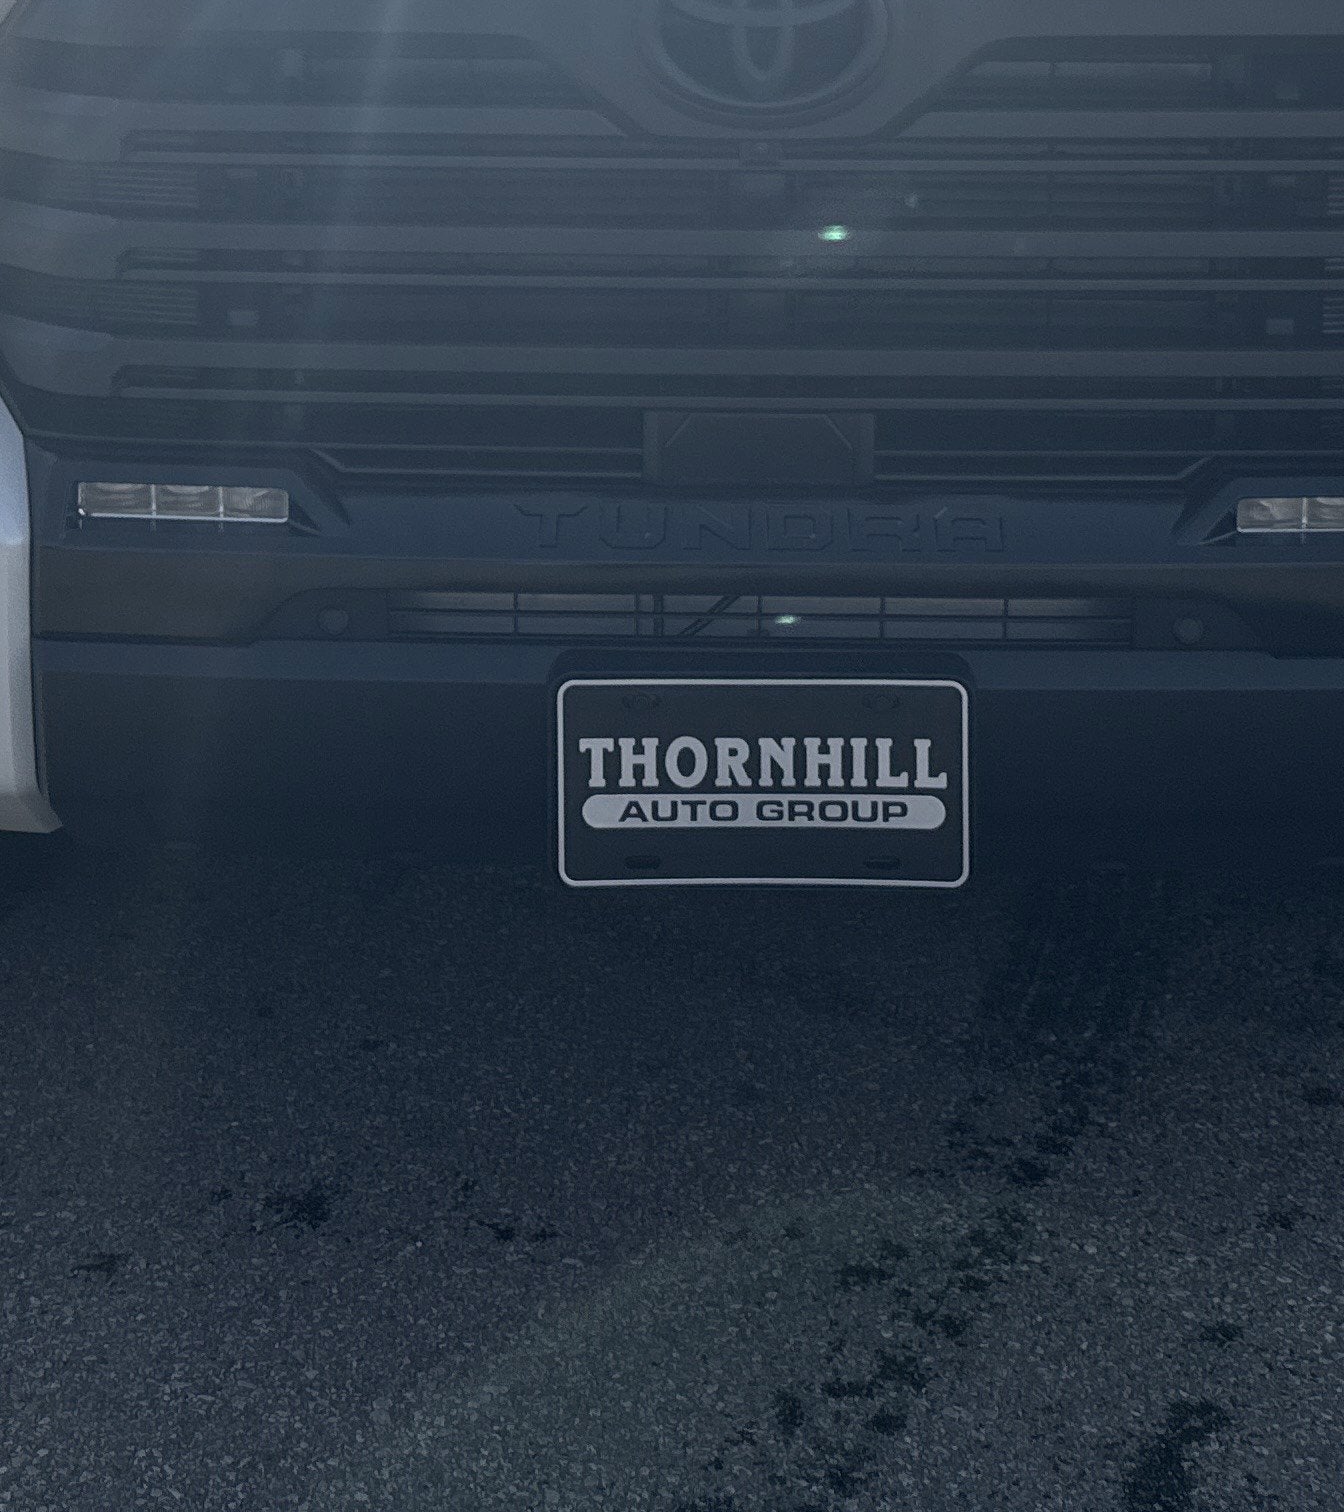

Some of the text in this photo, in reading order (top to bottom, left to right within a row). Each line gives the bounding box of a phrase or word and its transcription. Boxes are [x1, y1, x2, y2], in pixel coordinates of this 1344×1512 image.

[513, 503, 1006, 553] TUNDRA
[578, 735, 948, 789] THORNHILL
[618, 799, 909, 823] AUTO GROUP
